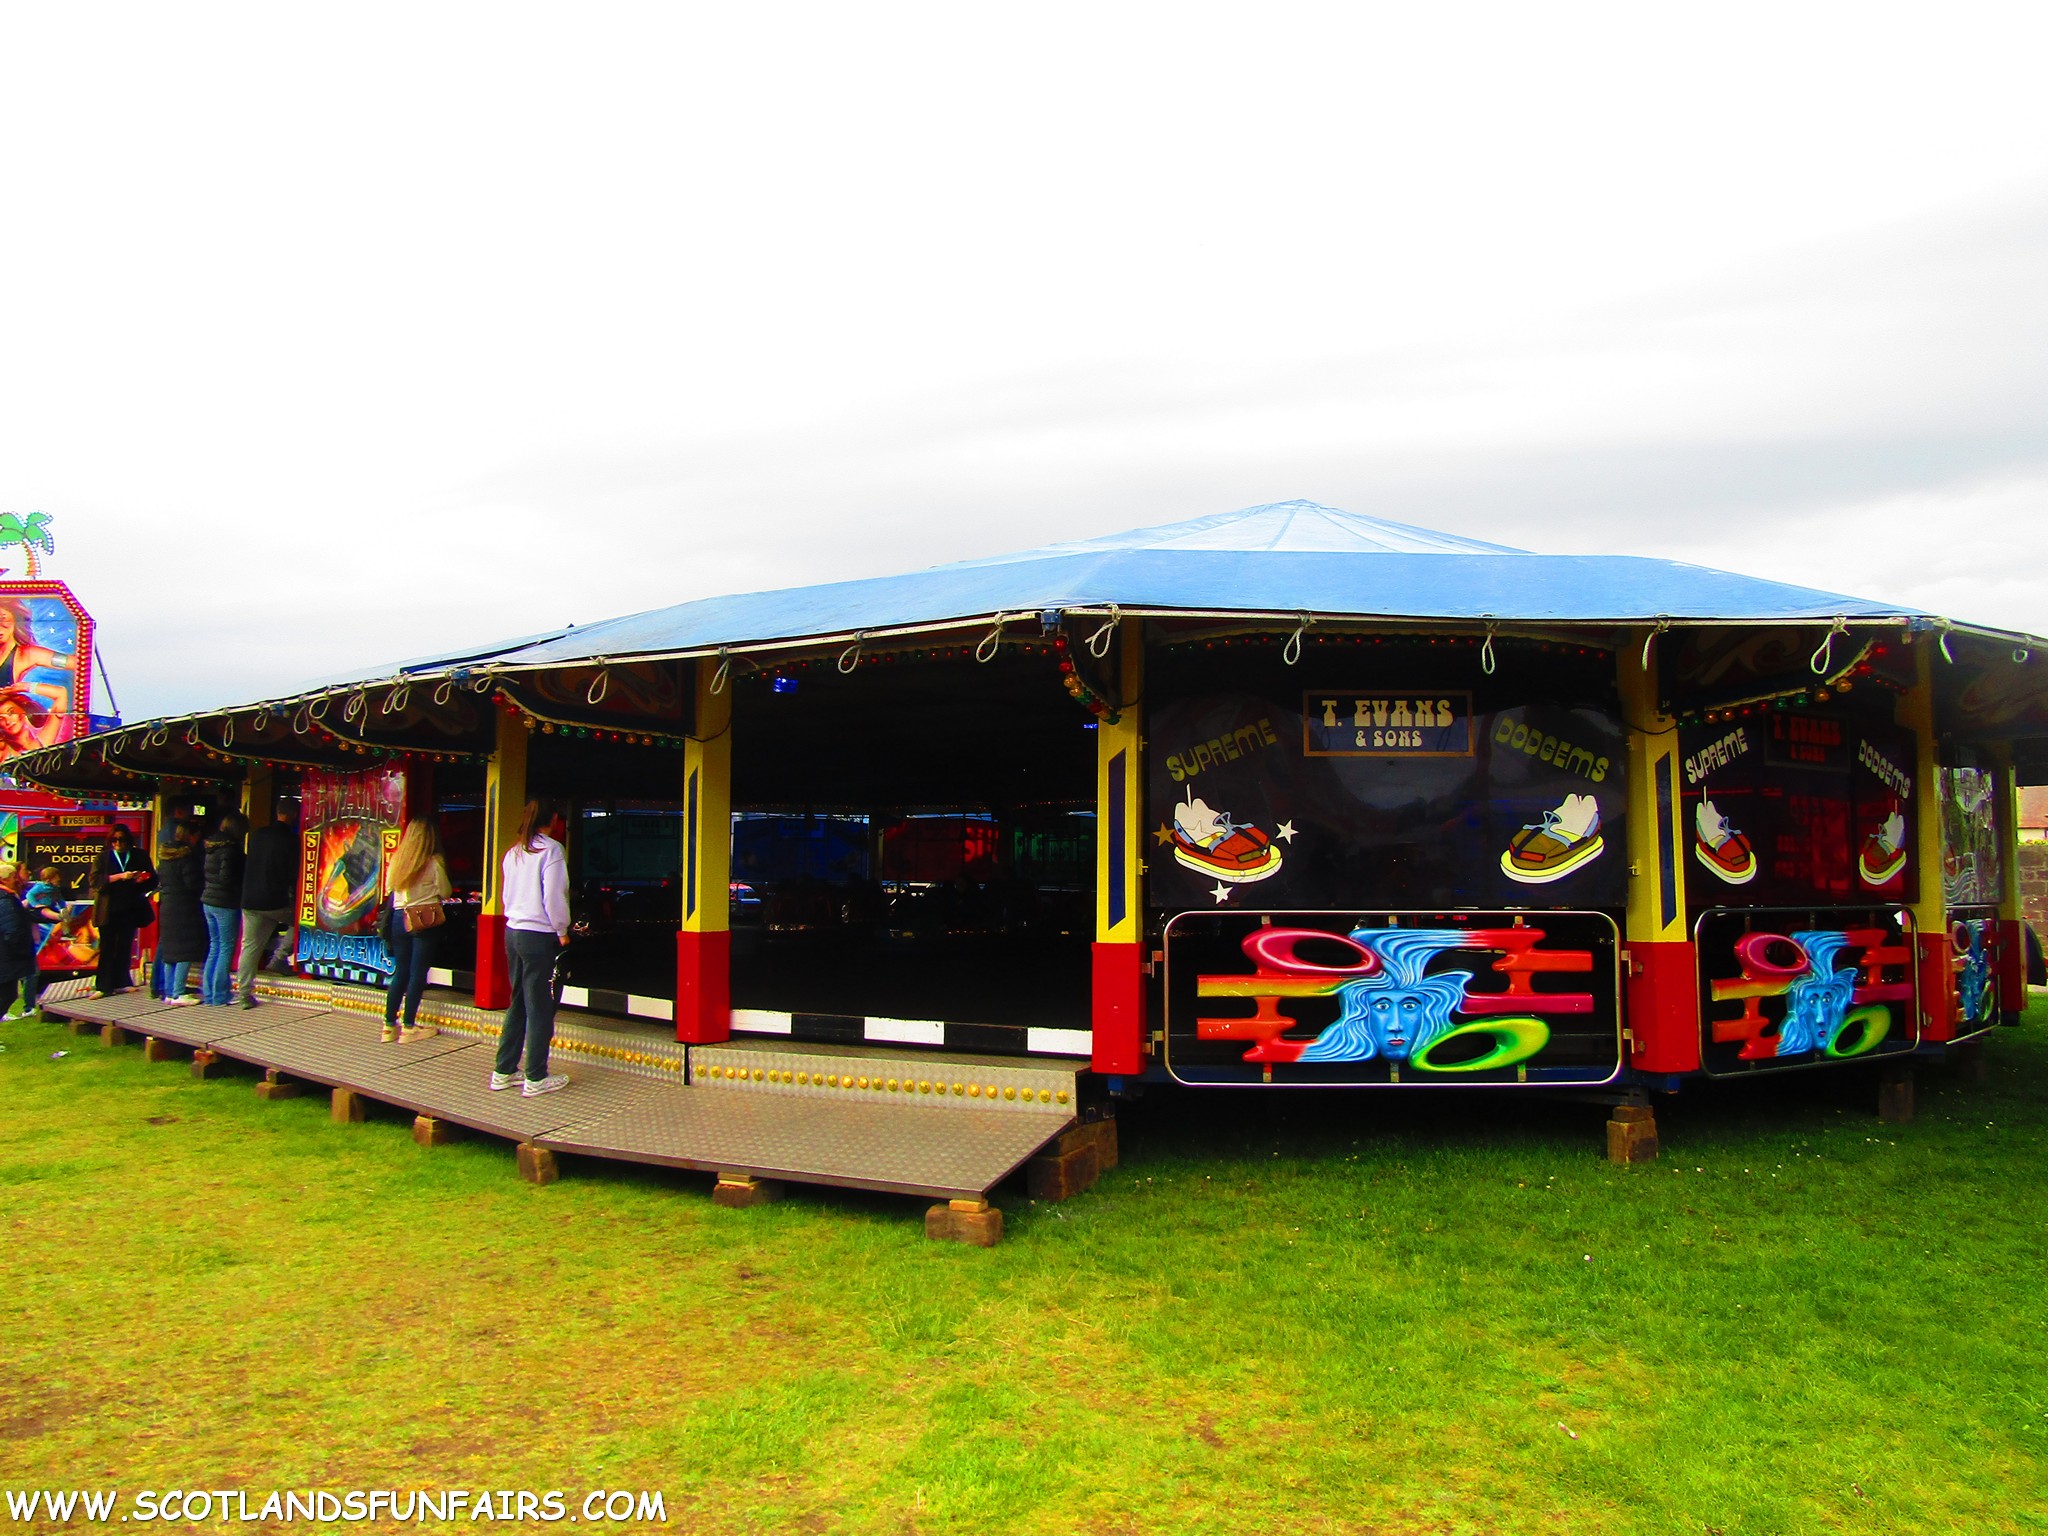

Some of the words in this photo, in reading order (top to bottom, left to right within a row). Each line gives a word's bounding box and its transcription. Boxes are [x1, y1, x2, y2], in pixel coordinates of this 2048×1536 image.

[1322, 700, 1342, 727] T.
[1354, 699, 1454, 727] EVANS
[1355, 730, 1368, 748] &
[1373, 730, 1423, 748] SONS
[1166, 718, 1277, 782] SUPREME
[1494, 716, 1610, 783] DODGEMS
[1685, 727, 1749, 785] SUPREME
[1857, 738, 1911, 799] DODGEMS
[35, 845, 60, 853] PAY
[65, 845, 104, 853] HERE
[302, 834, 317, 921] SUPREME
